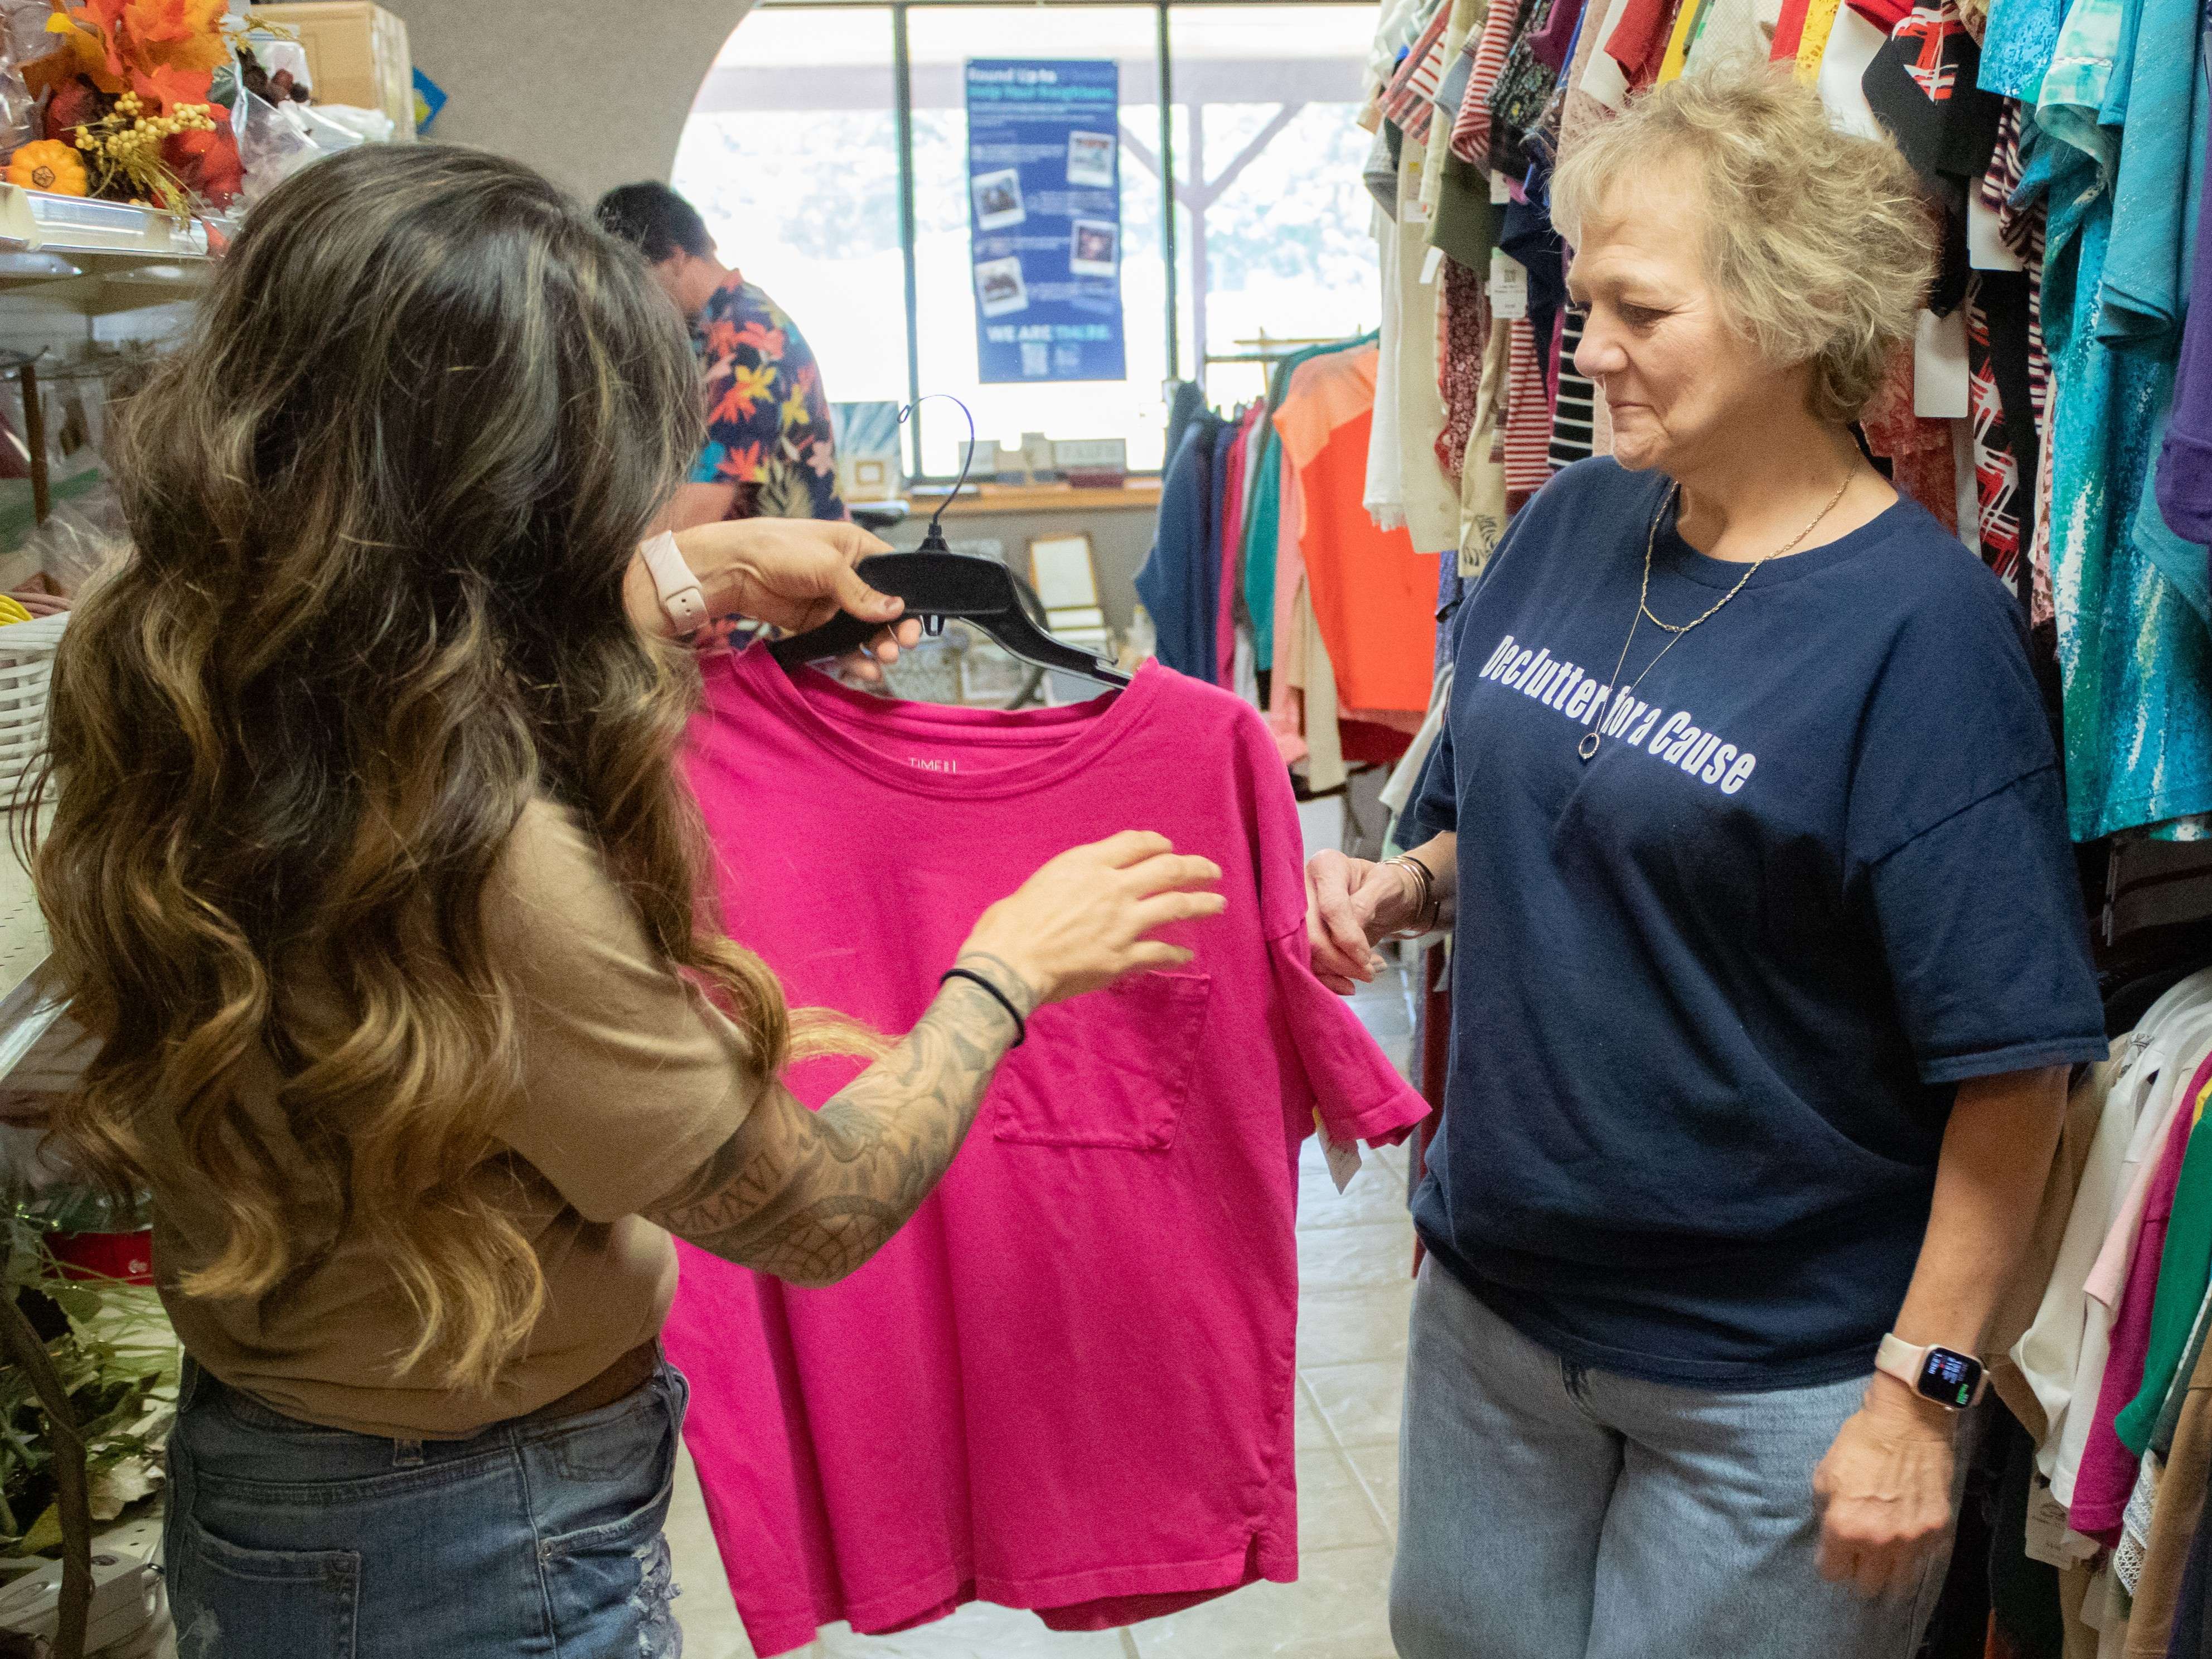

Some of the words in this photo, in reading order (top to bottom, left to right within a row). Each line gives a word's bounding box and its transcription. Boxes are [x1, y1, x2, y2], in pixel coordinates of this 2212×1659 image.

[1479, 635, 1613, 725] Declutter
[1600, 685, 1649, 738] for
[1627, 708, 1663, 747] a
[1648, 710, 1756, 795] Cause
